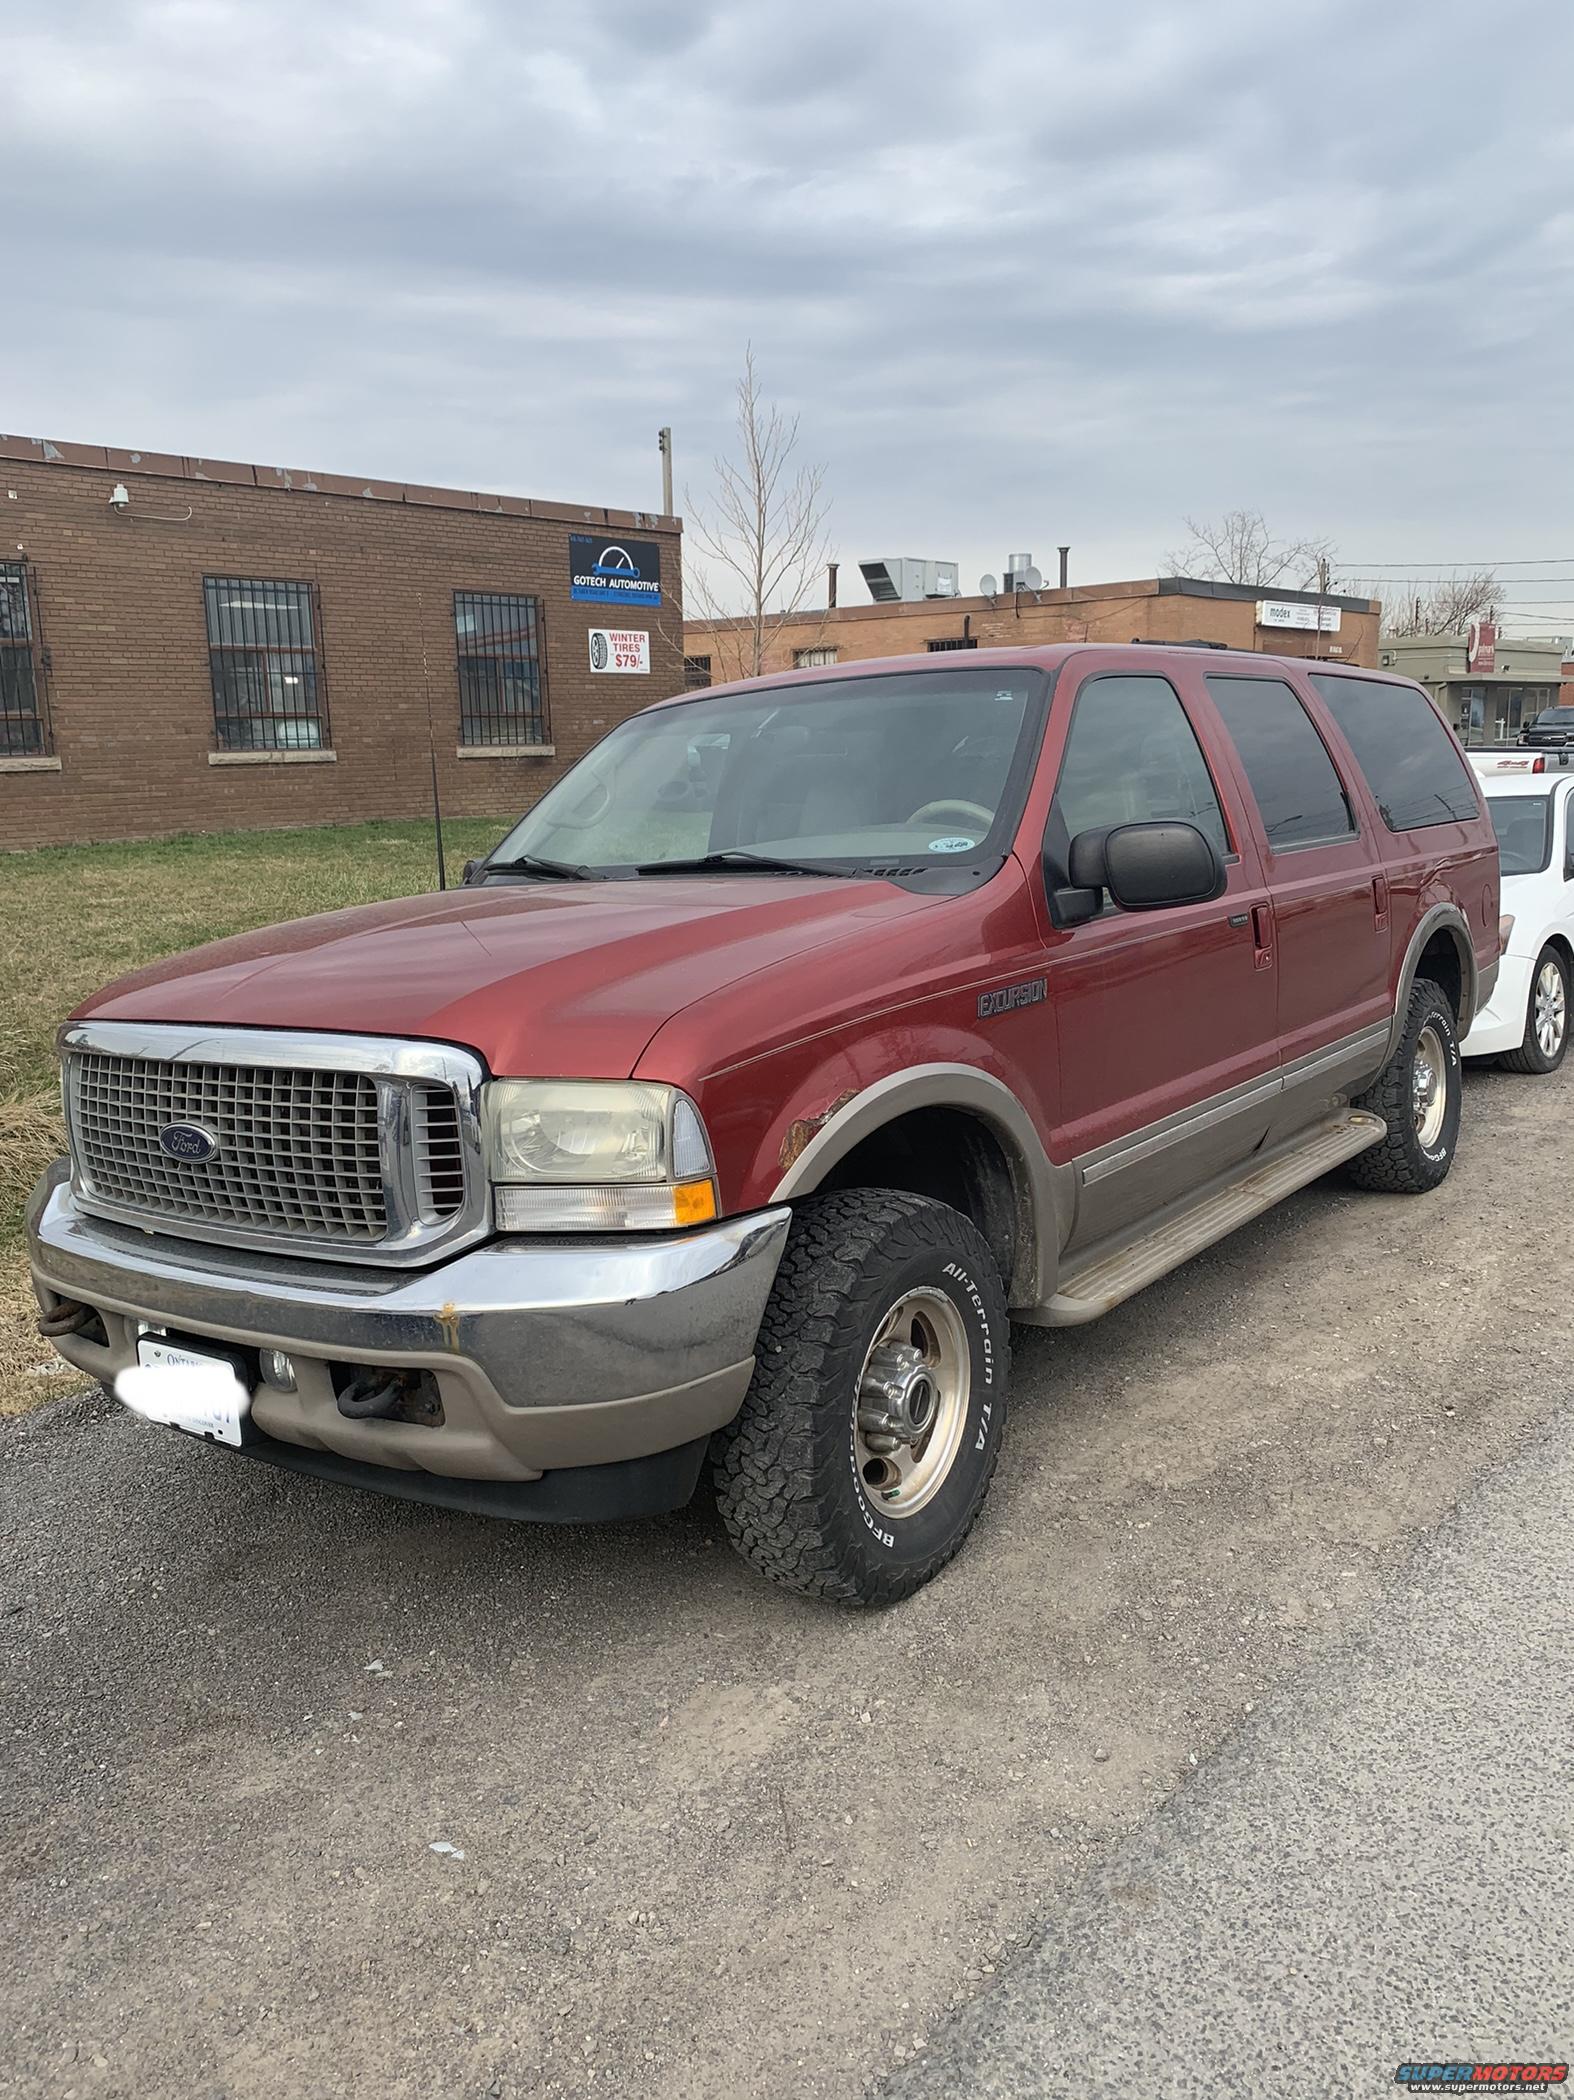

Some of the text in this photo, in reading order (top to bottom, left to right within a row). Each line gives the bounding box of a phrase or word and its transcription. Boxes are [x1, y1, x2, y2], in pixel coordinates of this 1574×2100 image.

[573, 575, 659, 591] GOTECH AUTOMOTIVE
[609, 632, 646, 643] WINTER
[613, 643, 641, 653] TIRES
[978, 978, 1048, 1016] EXCURSION
[171, 1131, 201, 1154] Ford
